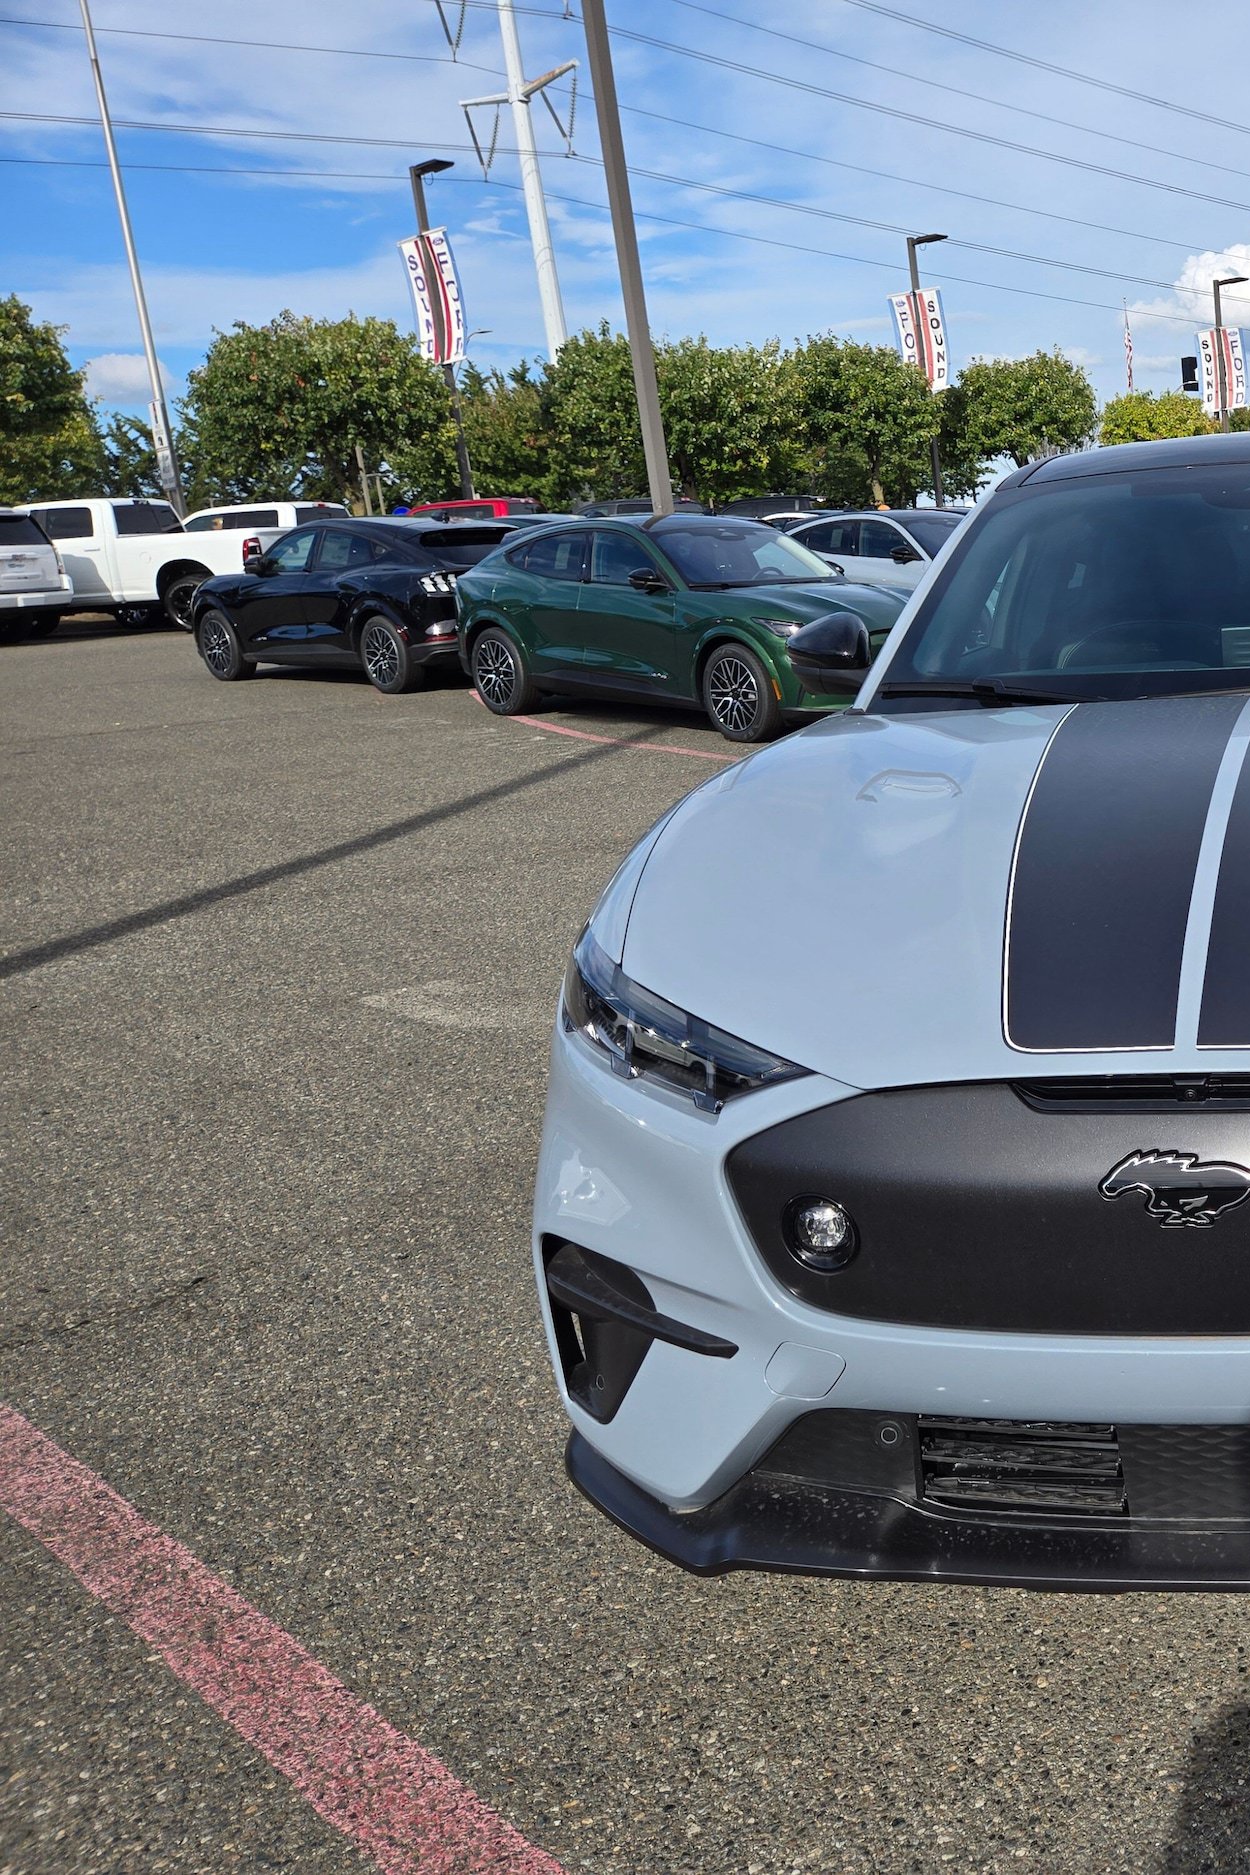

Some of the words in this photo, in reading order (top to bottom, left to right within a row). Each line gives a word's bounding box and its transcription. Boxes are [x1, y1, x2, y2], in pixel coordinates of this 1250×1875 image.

[927, 300, 946, 379] SOUND
[1201, 340, 1214, 403] SOUND
[1230, 340, 1245, 404] FORD
